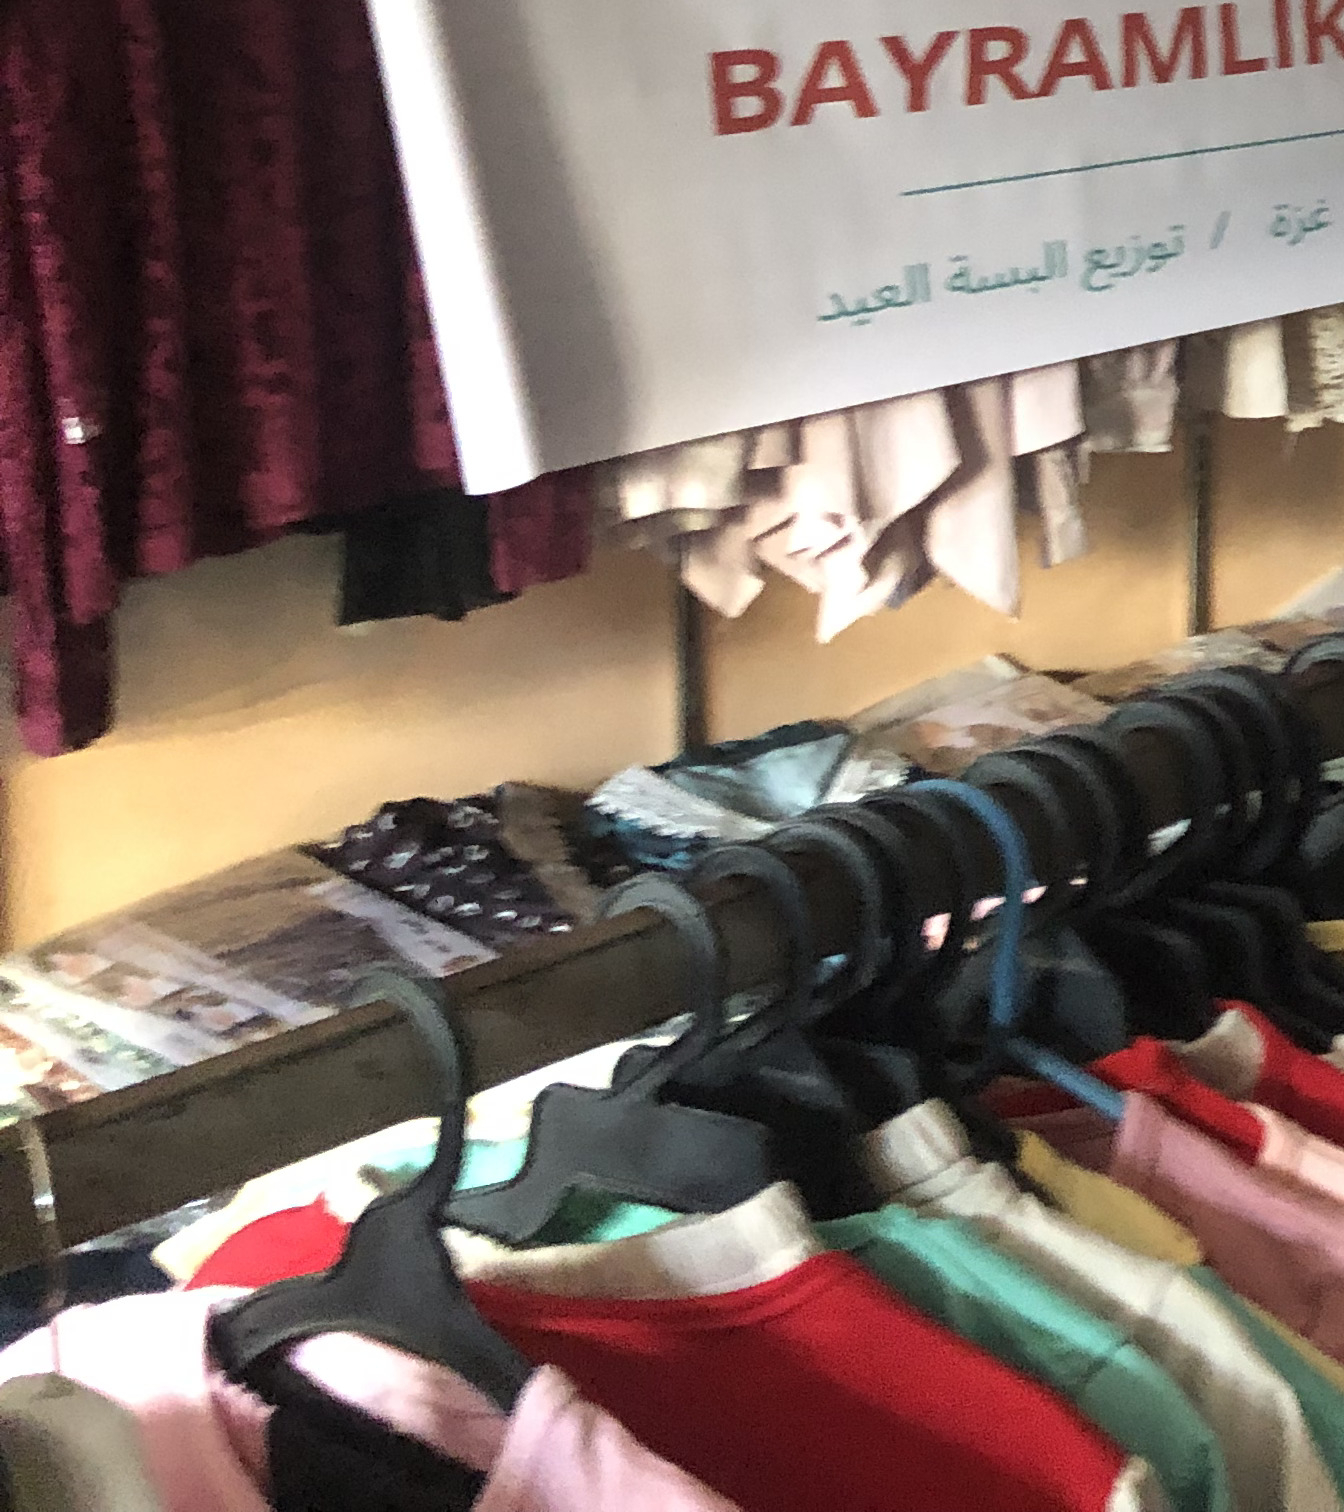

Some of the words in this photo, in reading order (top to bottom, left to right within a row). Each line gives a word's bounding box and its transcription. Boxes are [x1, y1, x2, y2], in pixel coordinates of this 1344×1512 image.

[1268, 197, 1334, 247] غزة
[1080, 223, 1187, 293] توزيع
[816, 261, 932, 327] العيد
